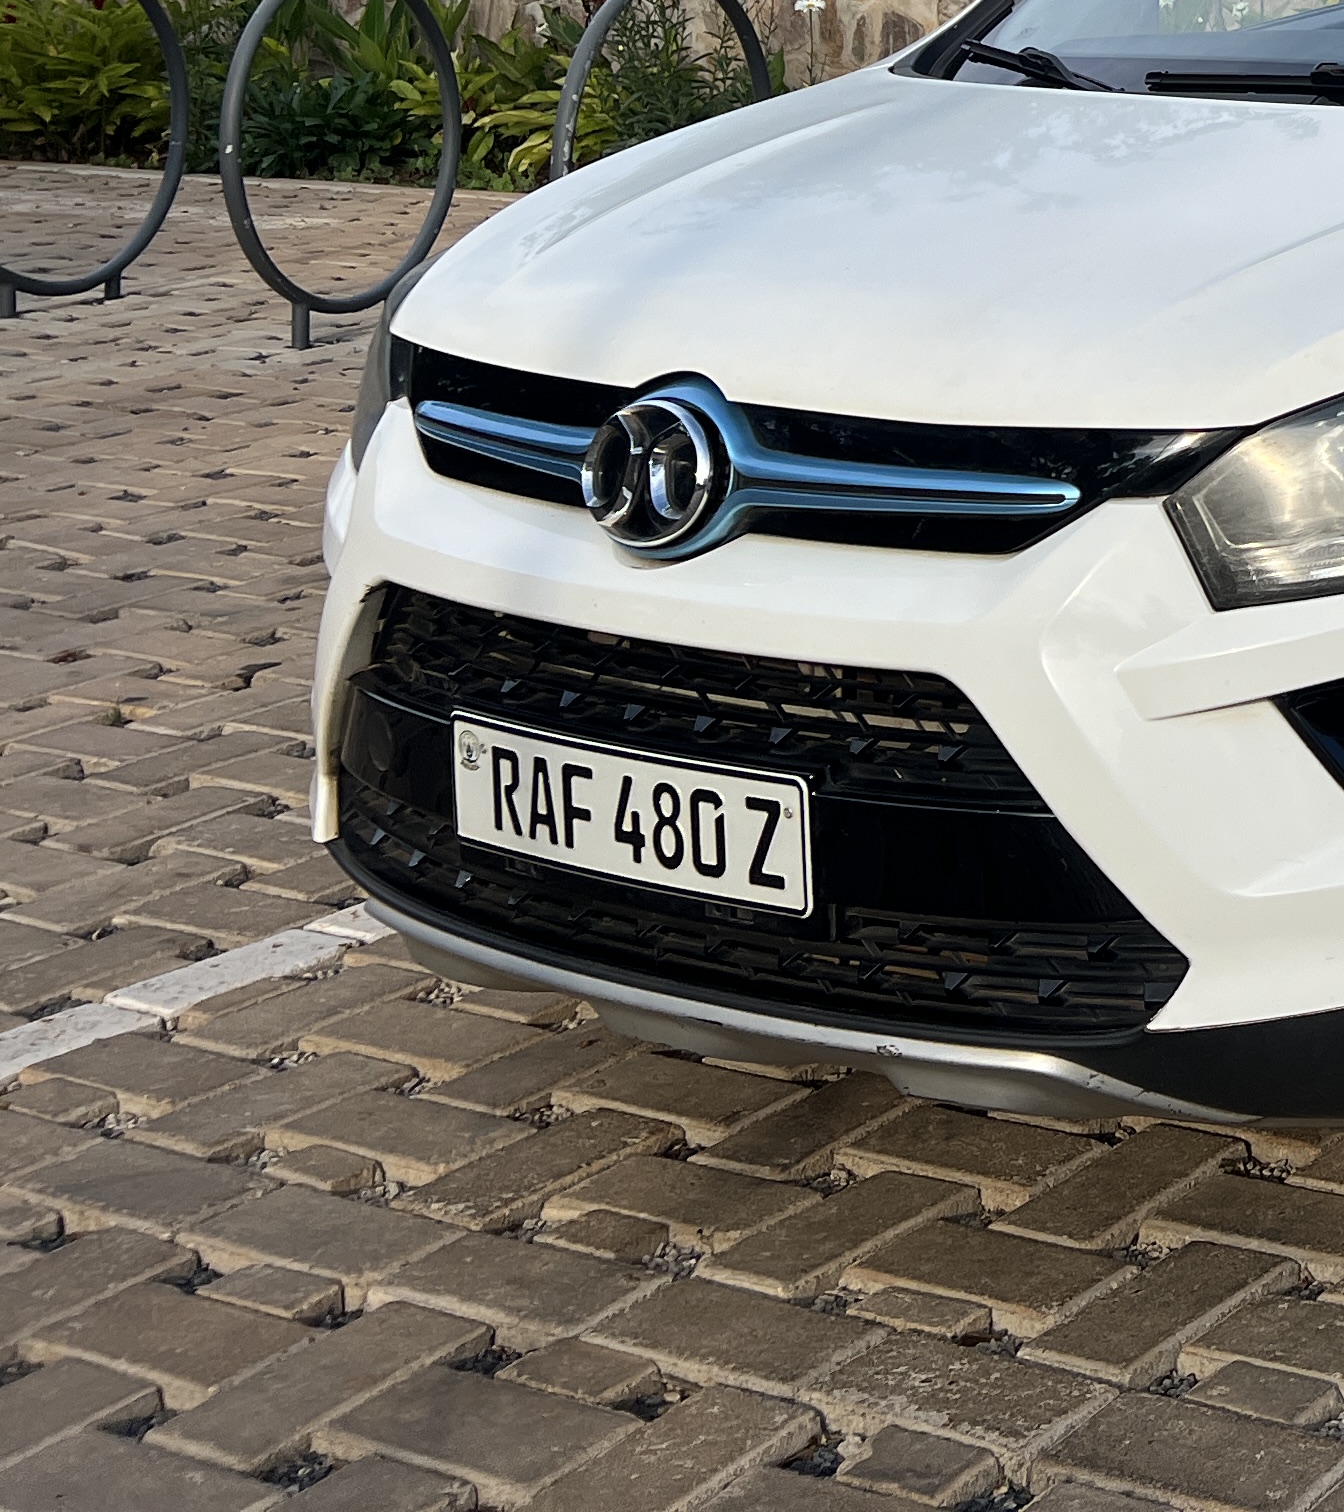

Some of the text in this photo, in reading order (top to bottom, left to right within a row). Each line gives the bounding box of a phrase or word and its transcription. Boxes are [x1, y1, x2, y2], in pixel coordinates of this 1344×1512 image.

[491, 745, 786, 890] RAF 480 Z
